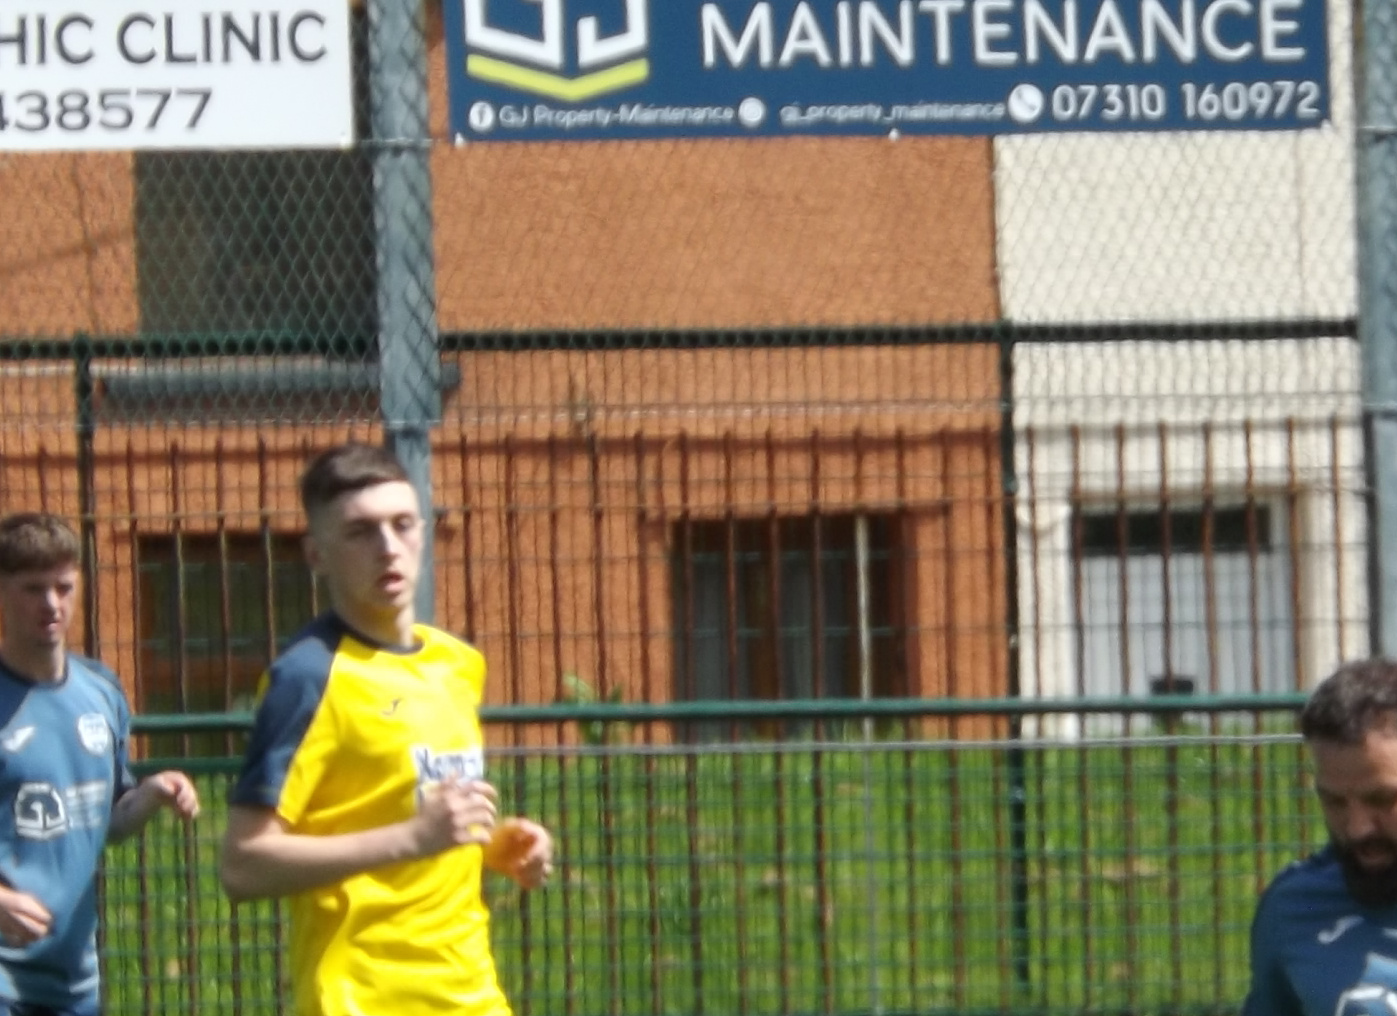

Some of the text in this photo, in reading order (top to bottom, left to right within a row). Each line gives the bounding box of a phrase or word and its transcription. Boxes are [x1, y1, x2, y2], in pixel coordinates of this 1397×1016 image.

[116, 9, 327, 64] CLINIC
[702, 0, 1306, 68] MAINTENANCE
[1051, 80, 1321, 120] 07310 160972
